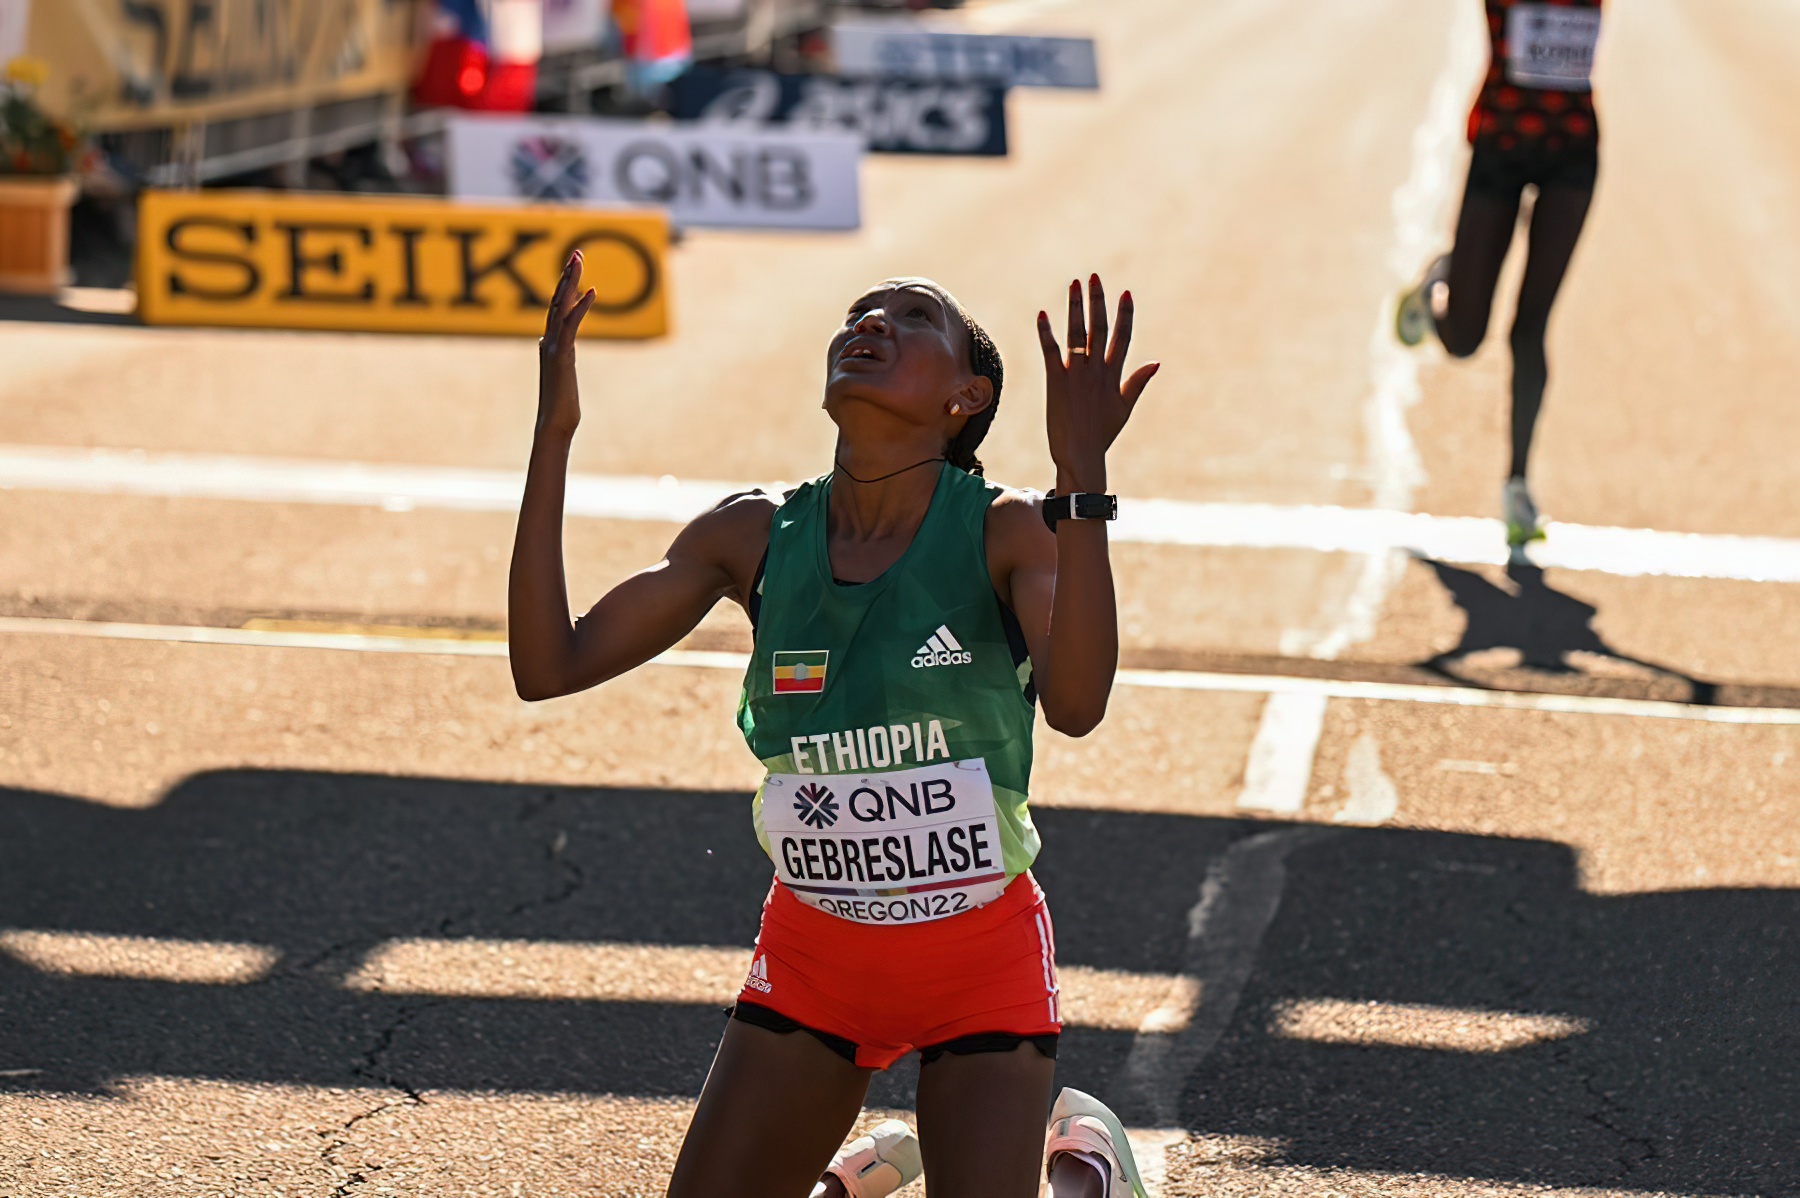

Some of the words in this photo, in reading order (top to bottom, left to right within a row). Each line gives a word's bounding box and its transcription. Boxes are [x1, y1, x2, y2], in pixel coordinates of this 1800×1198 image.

[614, 138, 816, 211] QNB
[162, 214, 658, 315] SEIKO
[910, 651, 972, 669] adidas
[790, 719, 951, 774] ETHIOPIA
[848, 778, 956, 823] QNB
[781, 822, 993, 883] GEBRESLASE
[818, 891, 969, 922] OREGON22
